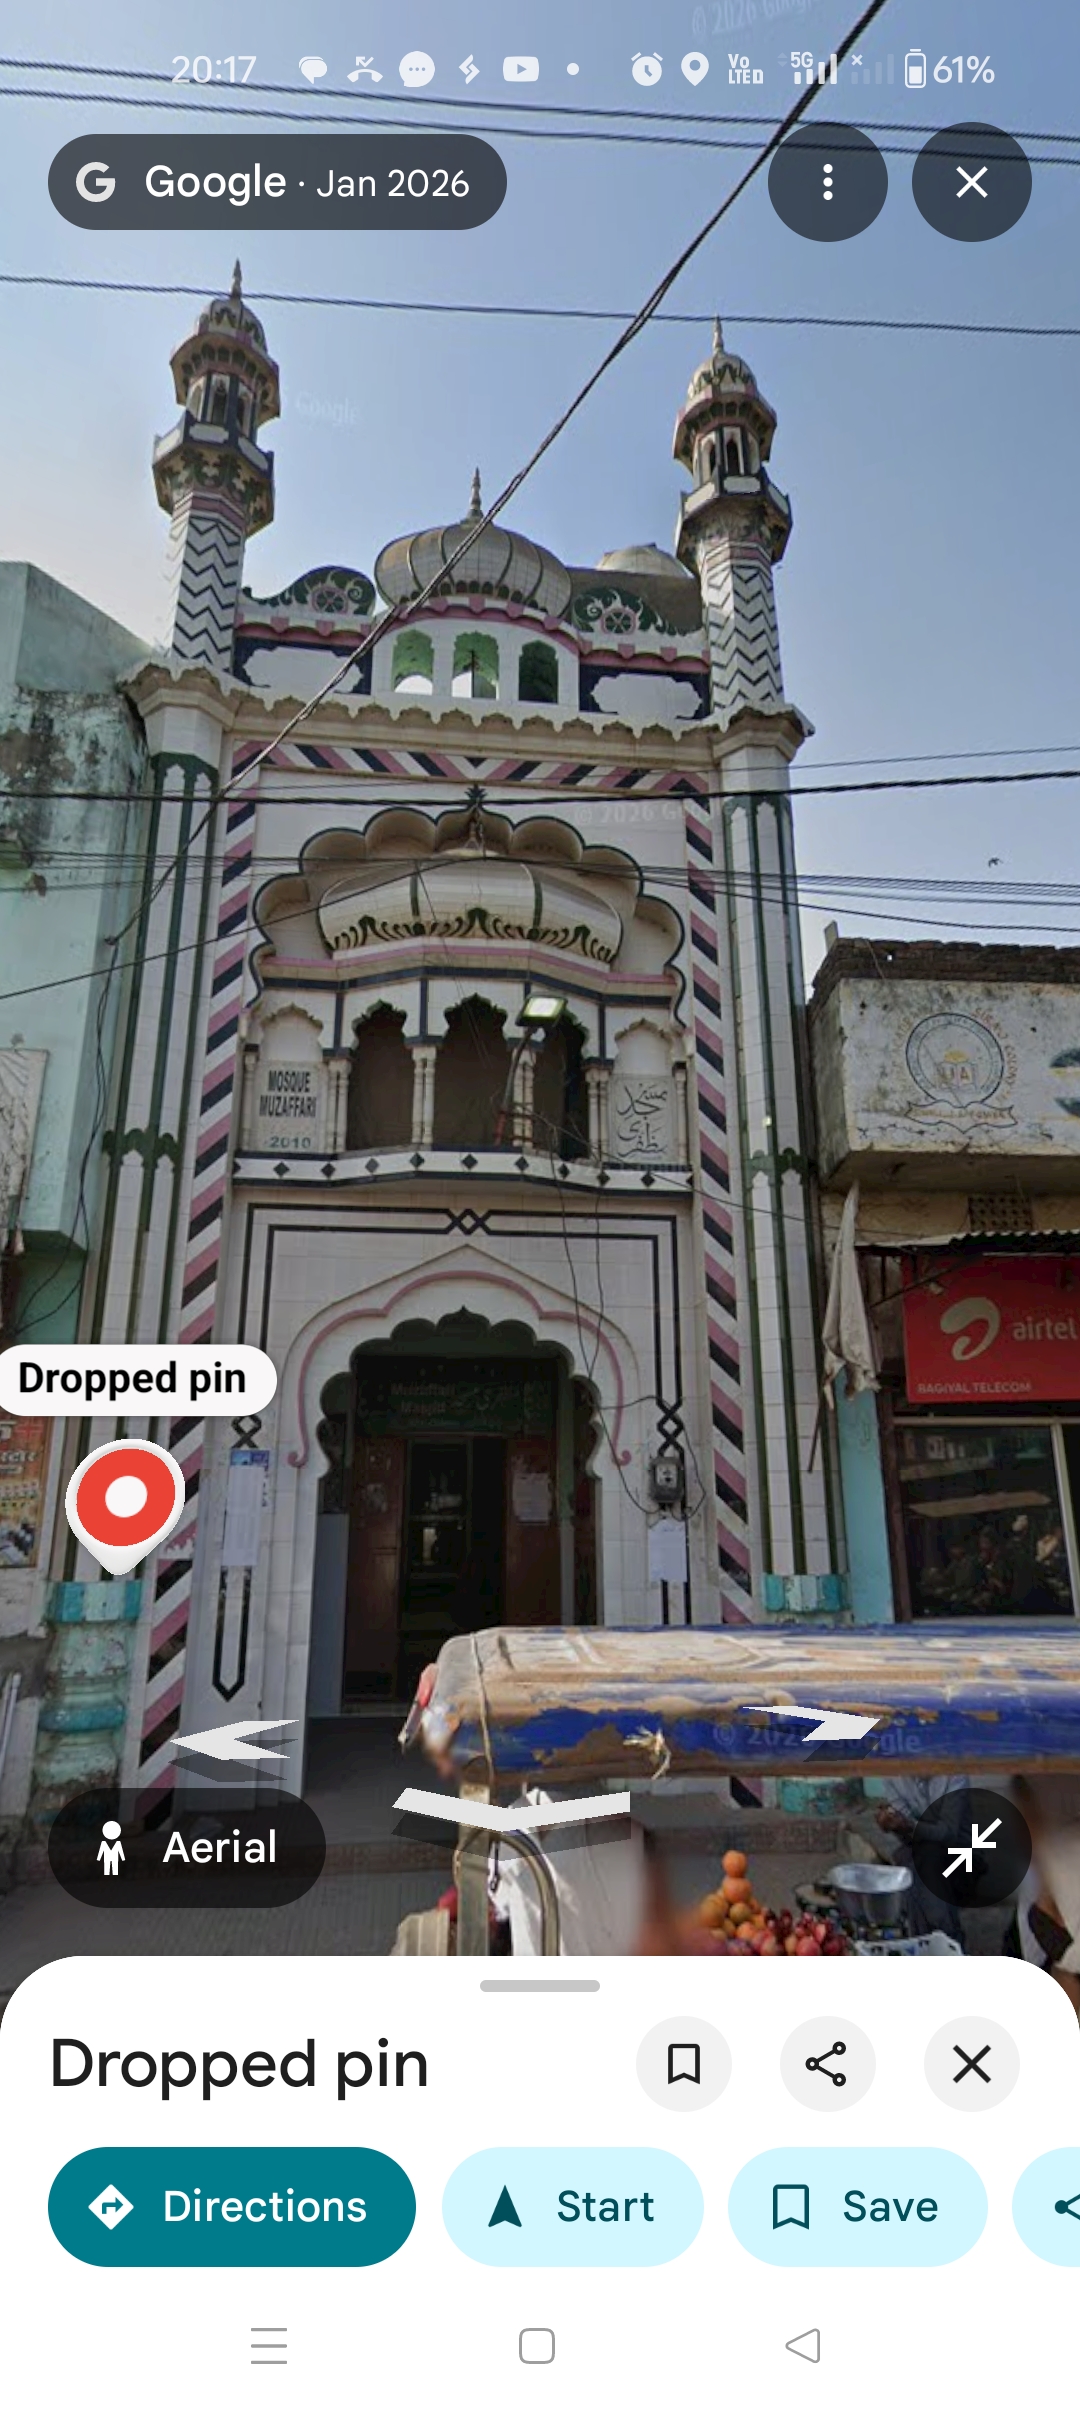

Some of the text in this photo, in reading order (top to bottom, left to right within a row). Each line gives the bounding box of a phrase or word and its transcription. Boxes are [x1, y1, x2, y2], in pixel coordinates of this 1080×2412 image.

[268, 1070, 311, 1092] MOSQUE
[260, 1095, 317, 1117] MUZAFFARI
[269, 1136, 311, 1149] 2010
[1013, 1316, 1078, 1340] airtel
[973, 1381, 1032, 1393] TELECOM
